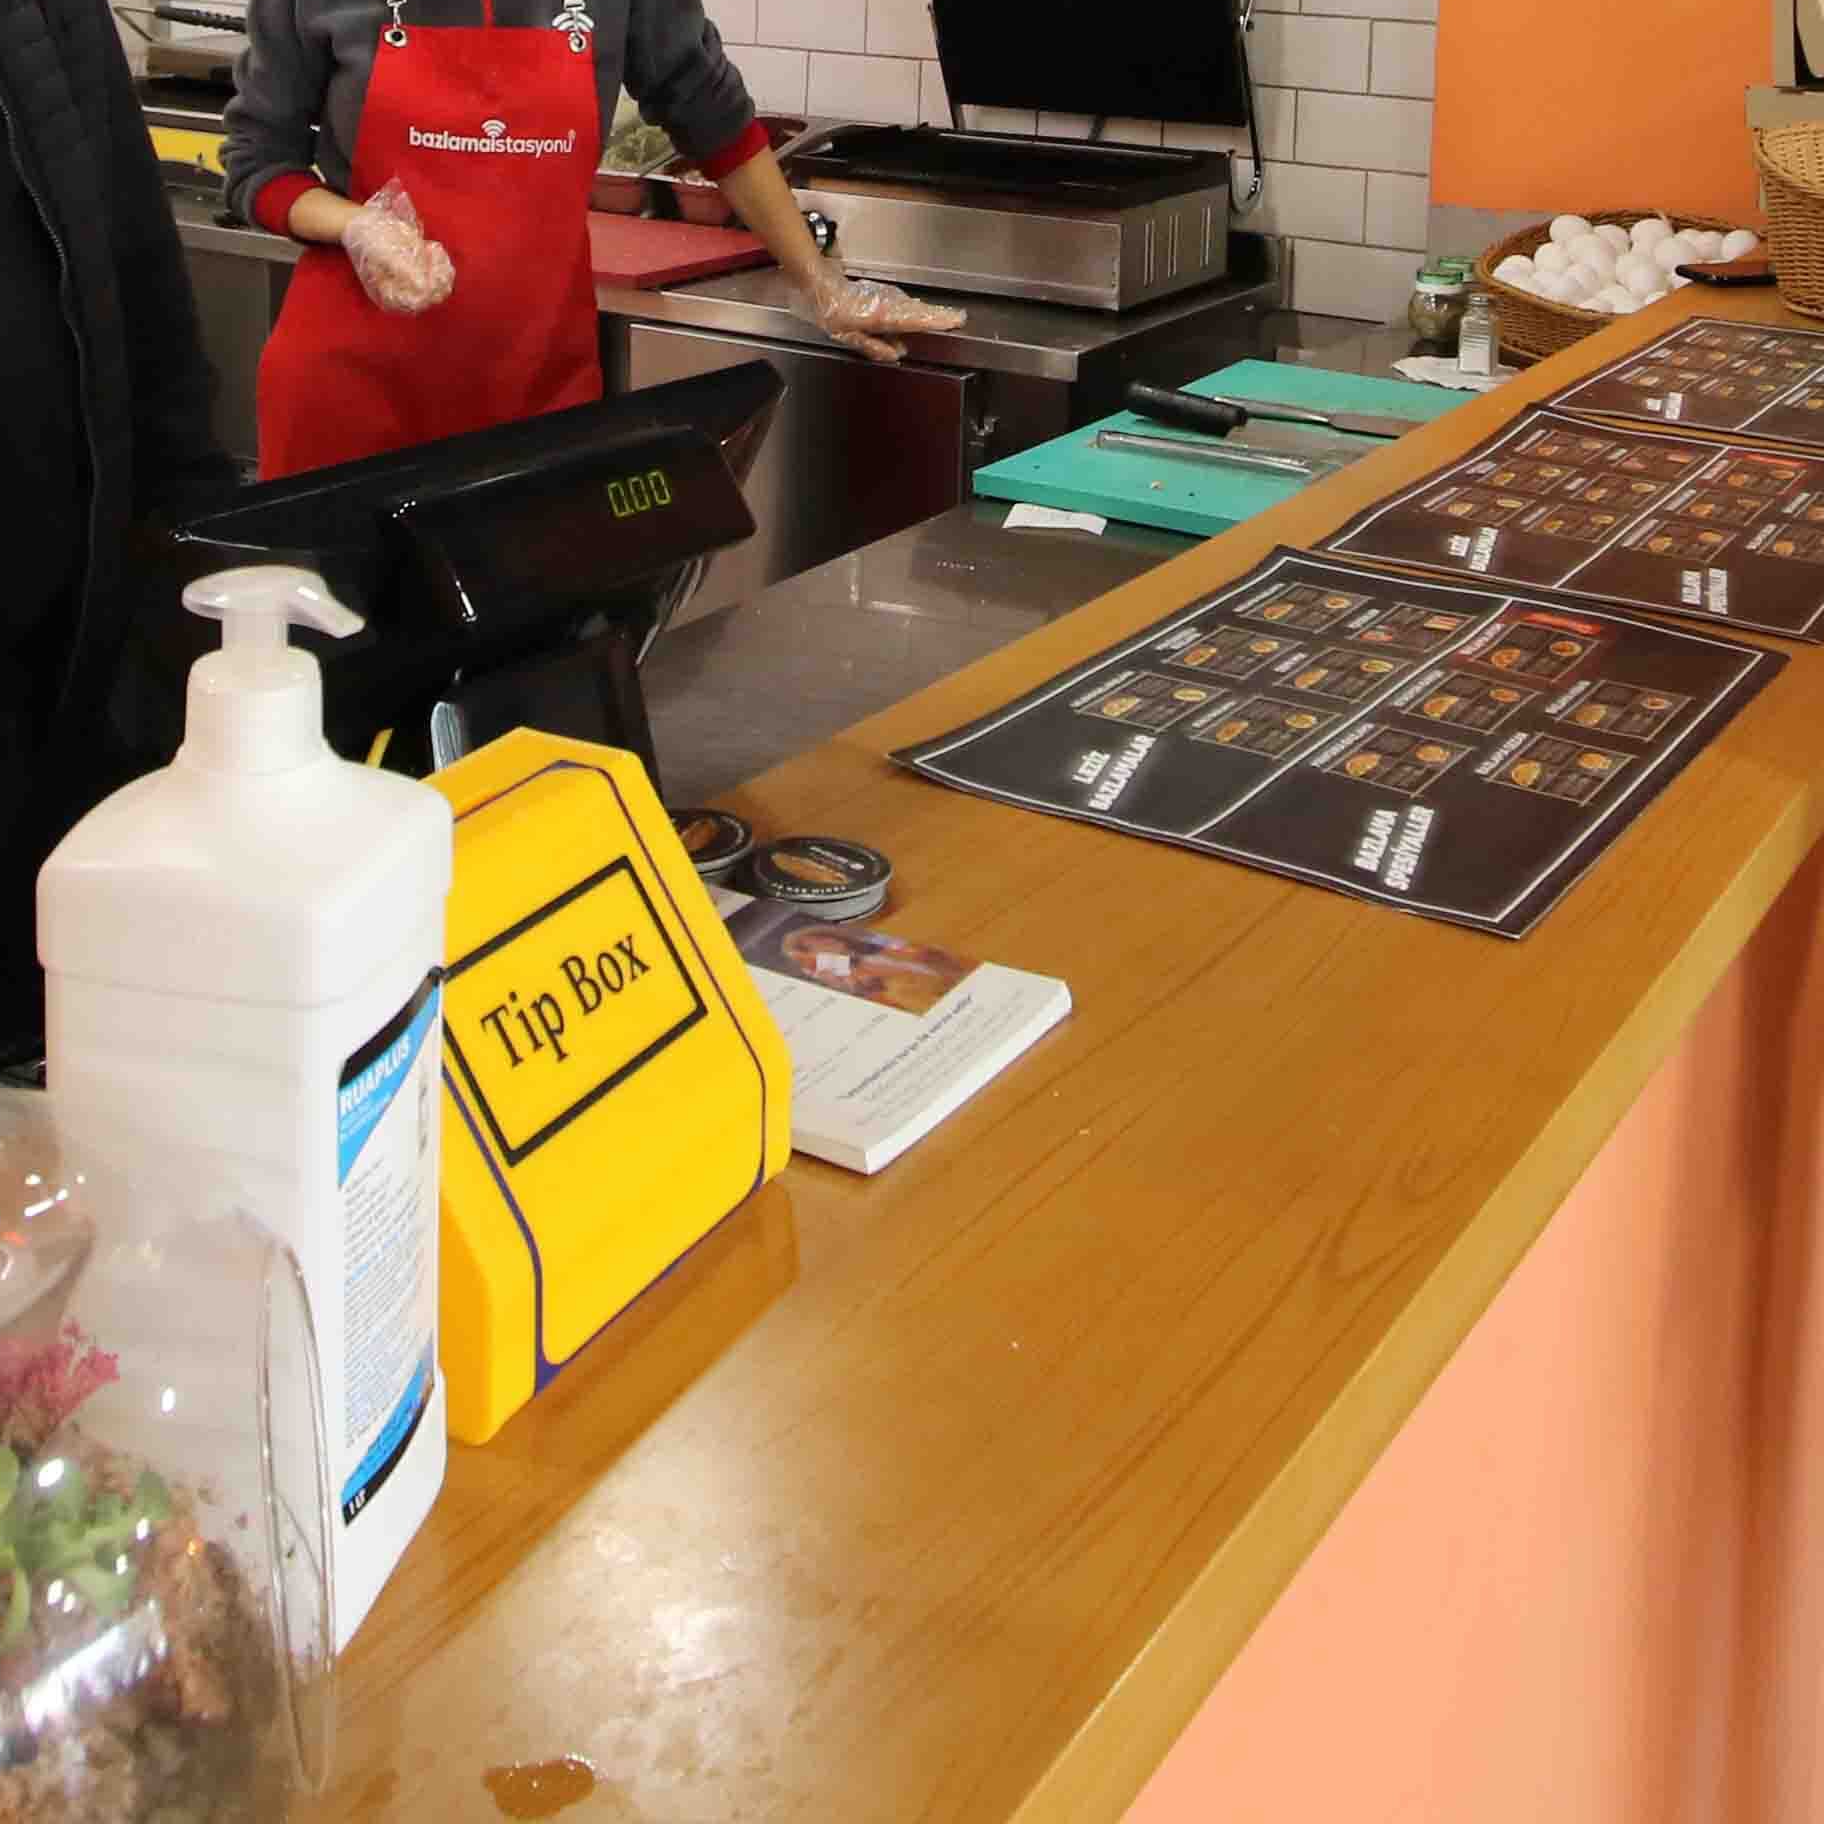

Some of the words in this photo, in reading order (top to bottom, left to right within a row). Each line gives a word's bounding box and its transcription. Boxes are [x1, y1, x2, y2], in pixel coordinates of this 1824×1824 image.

[1071, 750, 1112, 785] LEZİZ
[1087, 735, 1157, 812] BAZLAMALAR
[1353, 810, 1399, 872] BAZLAMA
[1383, 805, 1435, 891] SPESİYALLER
[481, 991, 569, 1066] Tip
[561, 931, 652, 1015] Box
